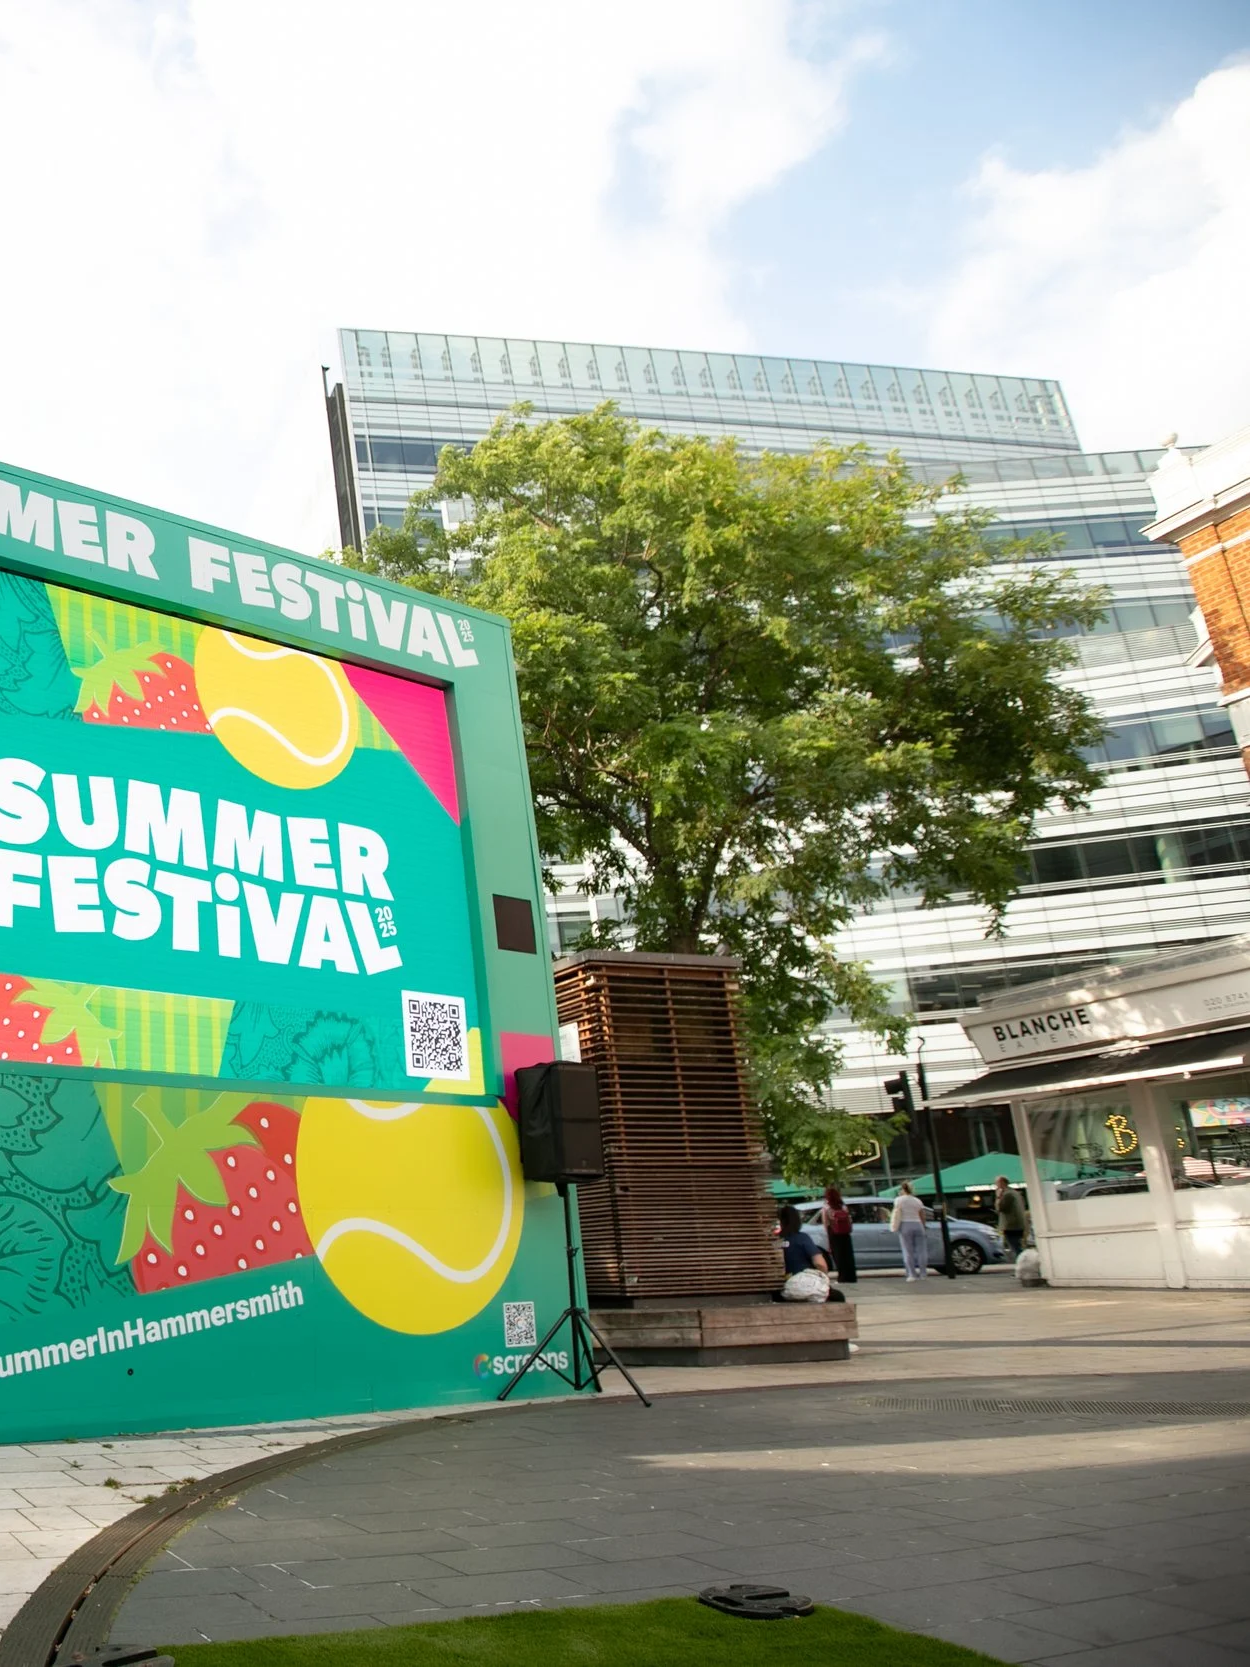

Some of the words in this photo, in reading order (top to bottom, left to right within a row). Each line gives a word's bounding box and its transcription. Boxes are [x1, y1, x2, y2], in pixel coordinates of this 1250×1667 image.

[374, 905, 393, 923] 20
[379, 920, 398, 938] 25
[993, 1008, 1091, 1042] BLANCHE
